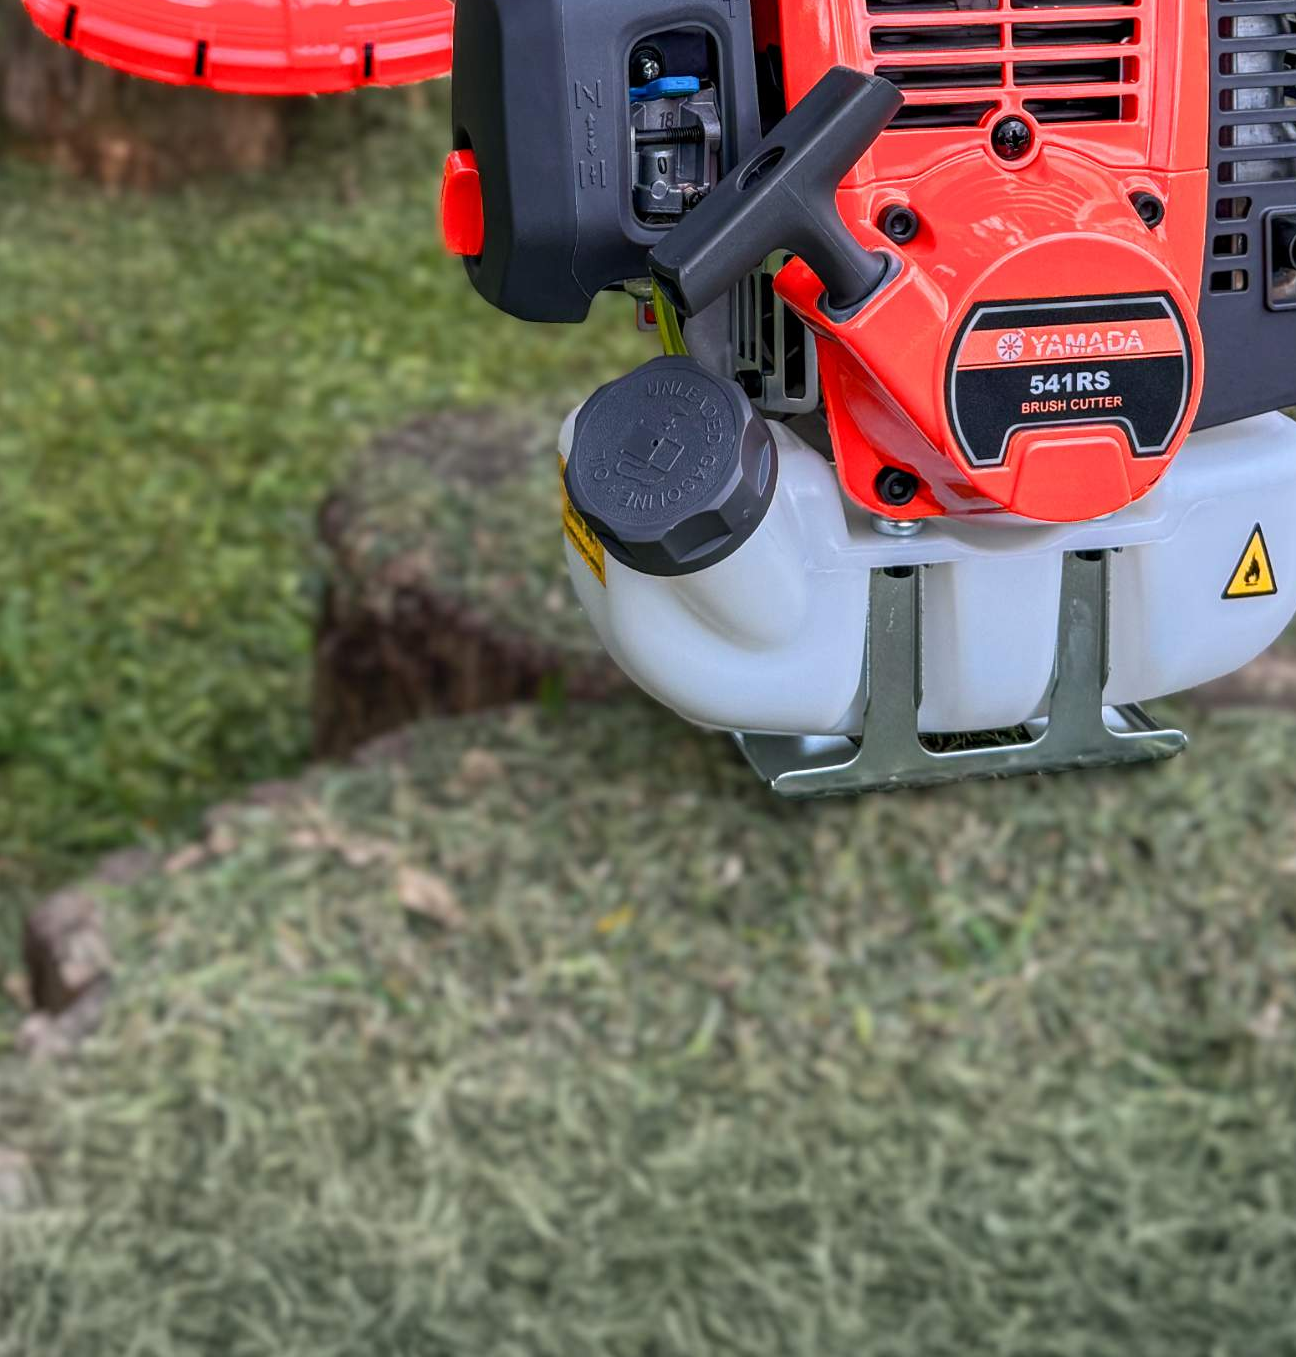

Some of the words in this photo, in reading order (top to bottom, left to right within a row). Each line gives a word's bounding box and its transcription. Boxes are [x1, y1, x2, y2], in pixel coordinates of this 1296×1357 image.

[1030, 329, 1144, 357] YAMADA
[1029, 371, 1111, 395] 541RS
[1021, 399, 1067, 414] BRUSH
[1070, 396, 1123, 411] CUTTER
